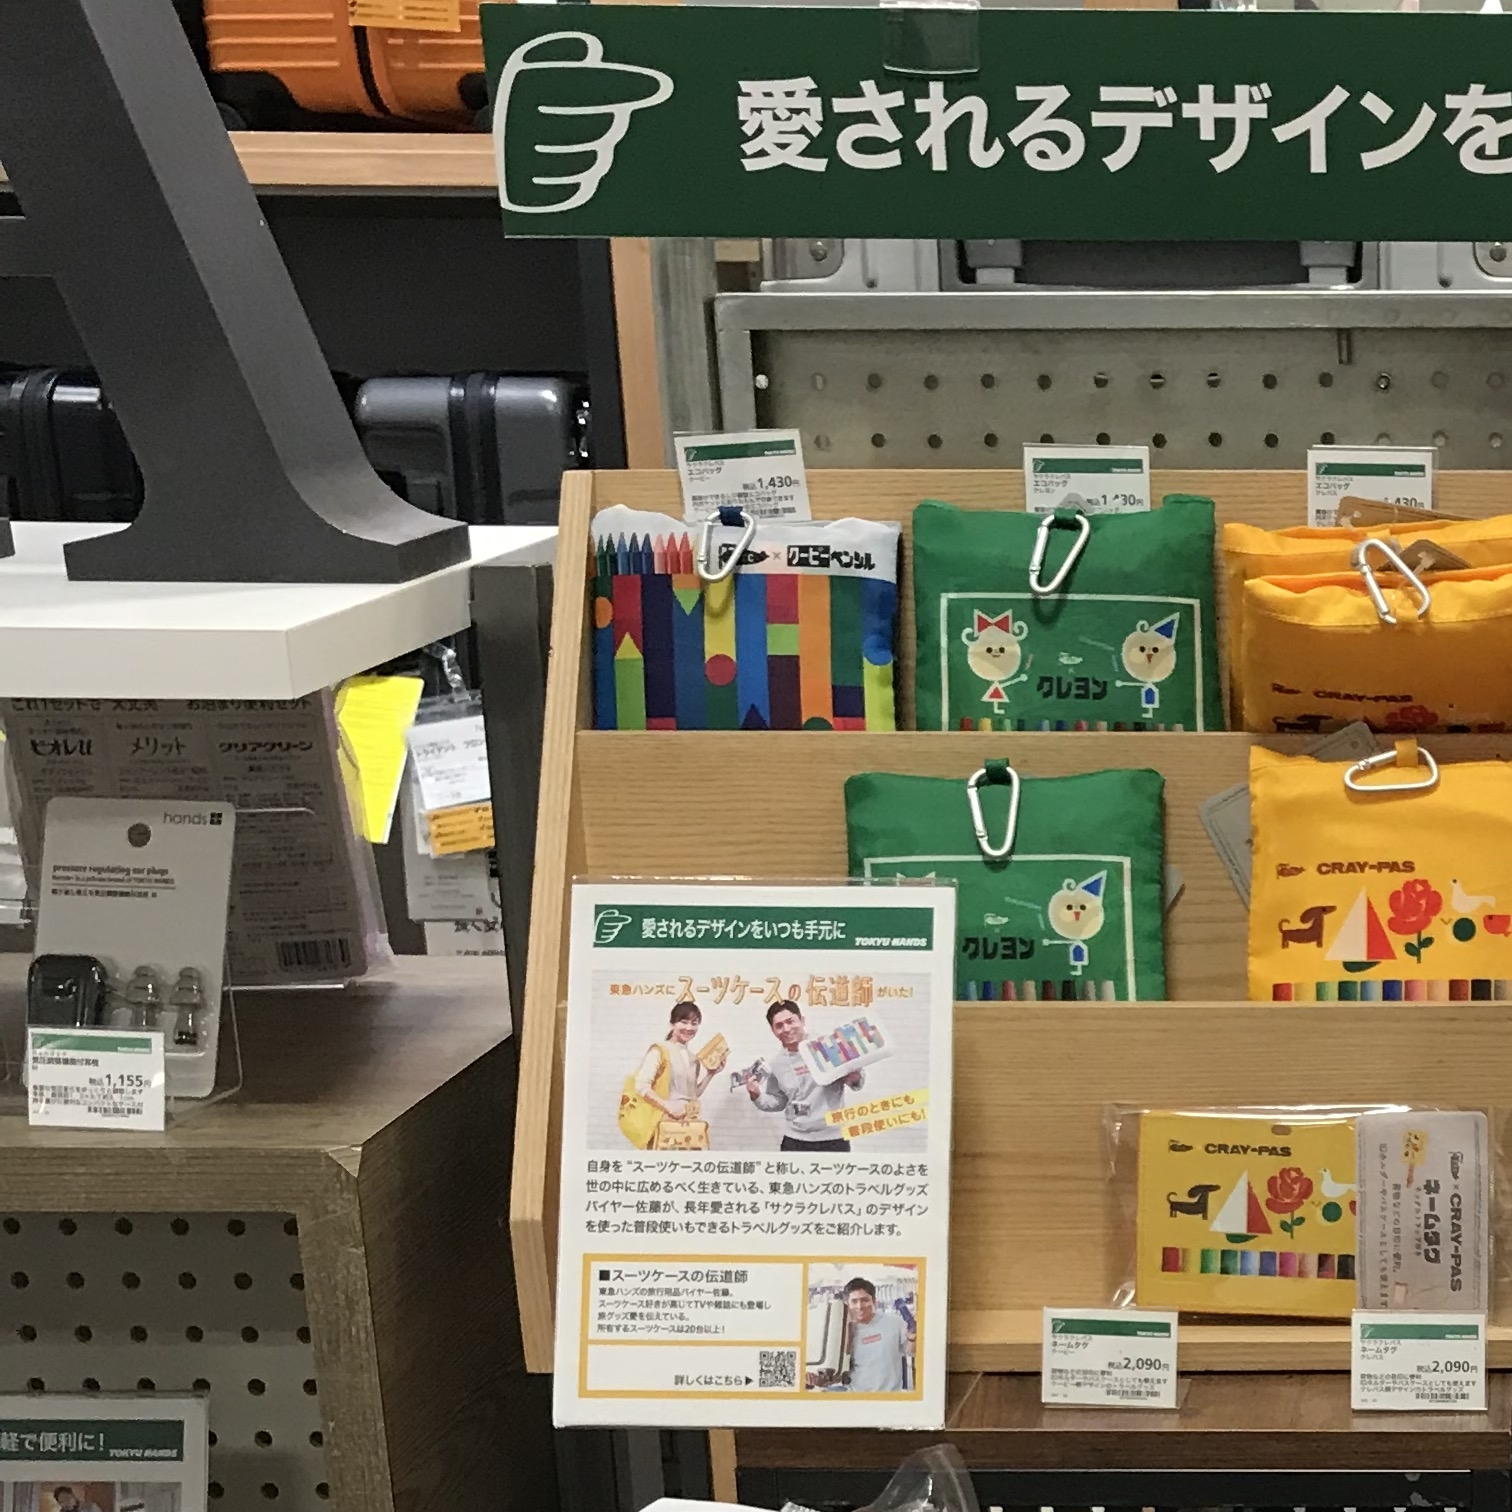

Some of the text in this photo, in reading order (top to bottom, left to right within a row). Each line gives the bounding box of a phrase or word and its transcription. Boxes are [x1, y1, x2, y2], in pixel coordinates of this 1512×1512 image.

[1037, 676, 1108, 700] クレヨン
[130, 738, 187, 755] メリット
[163, 811, 208, 825] hands
[1316, 861, 1416, 876] CRAY-PAS
[641, 919, 846, 941] 愛されるデザインをいつも手元に
[962, 937, 1036, 961] クレヨン
[830, 1093, 915, 1125] 旅行のときにも
[1204, 1142, 1292, 1158] CRAY-PAS
[1423, 1179, 1442, 1264] ネームタグ
[1450, 1193, 1463, 1292] CRAY-PAS
